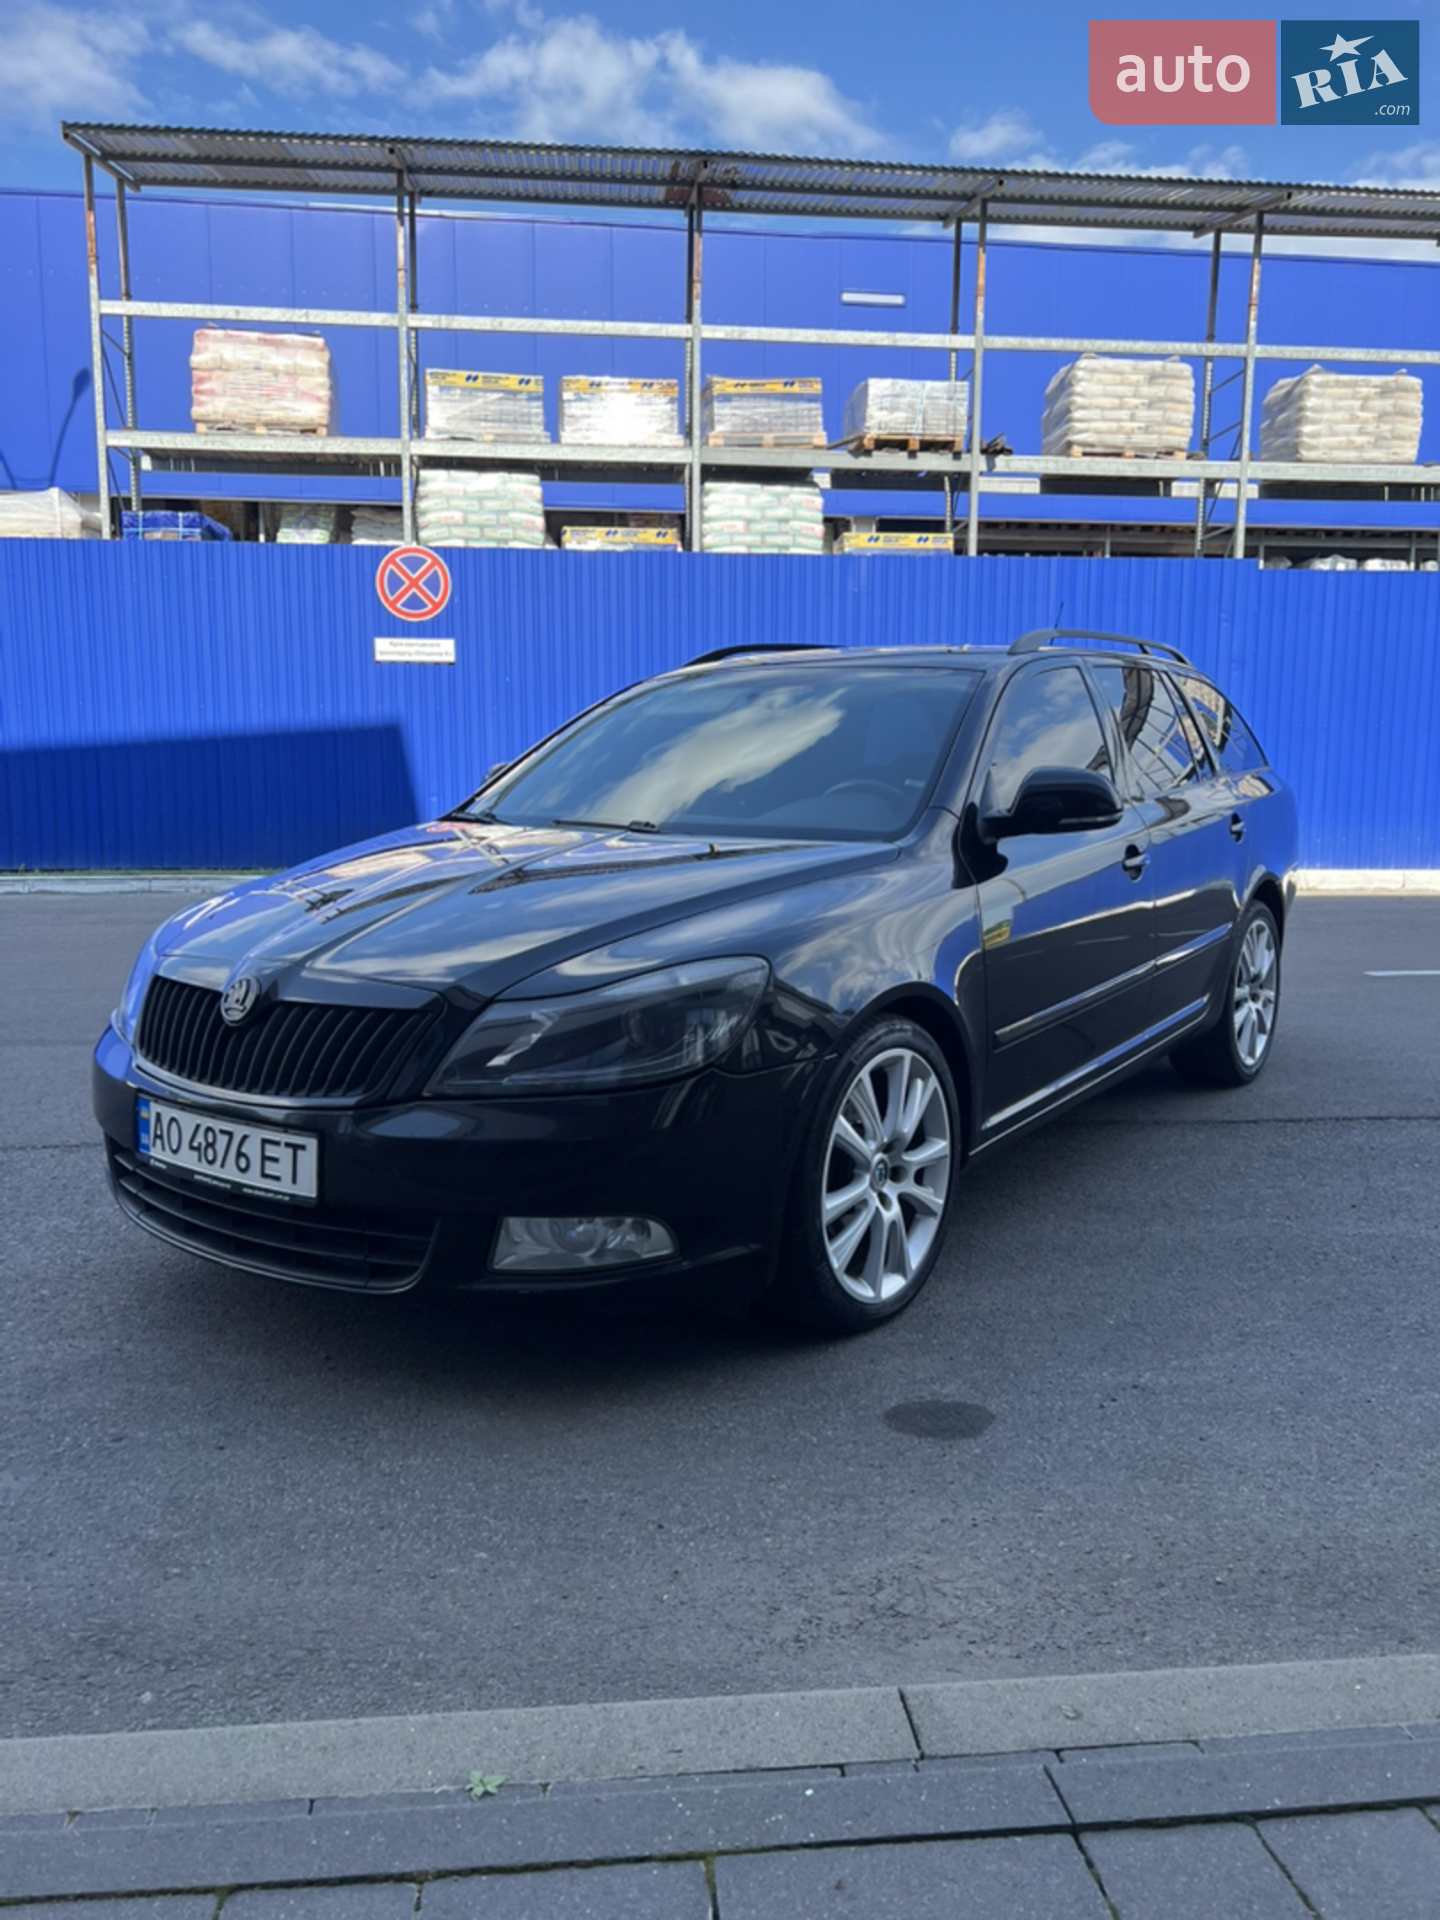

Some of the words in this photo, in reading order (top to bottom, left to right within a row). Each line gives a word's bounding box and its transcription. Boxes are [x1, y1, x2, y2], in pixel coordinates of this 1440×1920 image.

[152, 1112, 182, 1154] AO
[189, 1124, 250, 1173] 4876
[260, 1138, 306, 1185] ET
